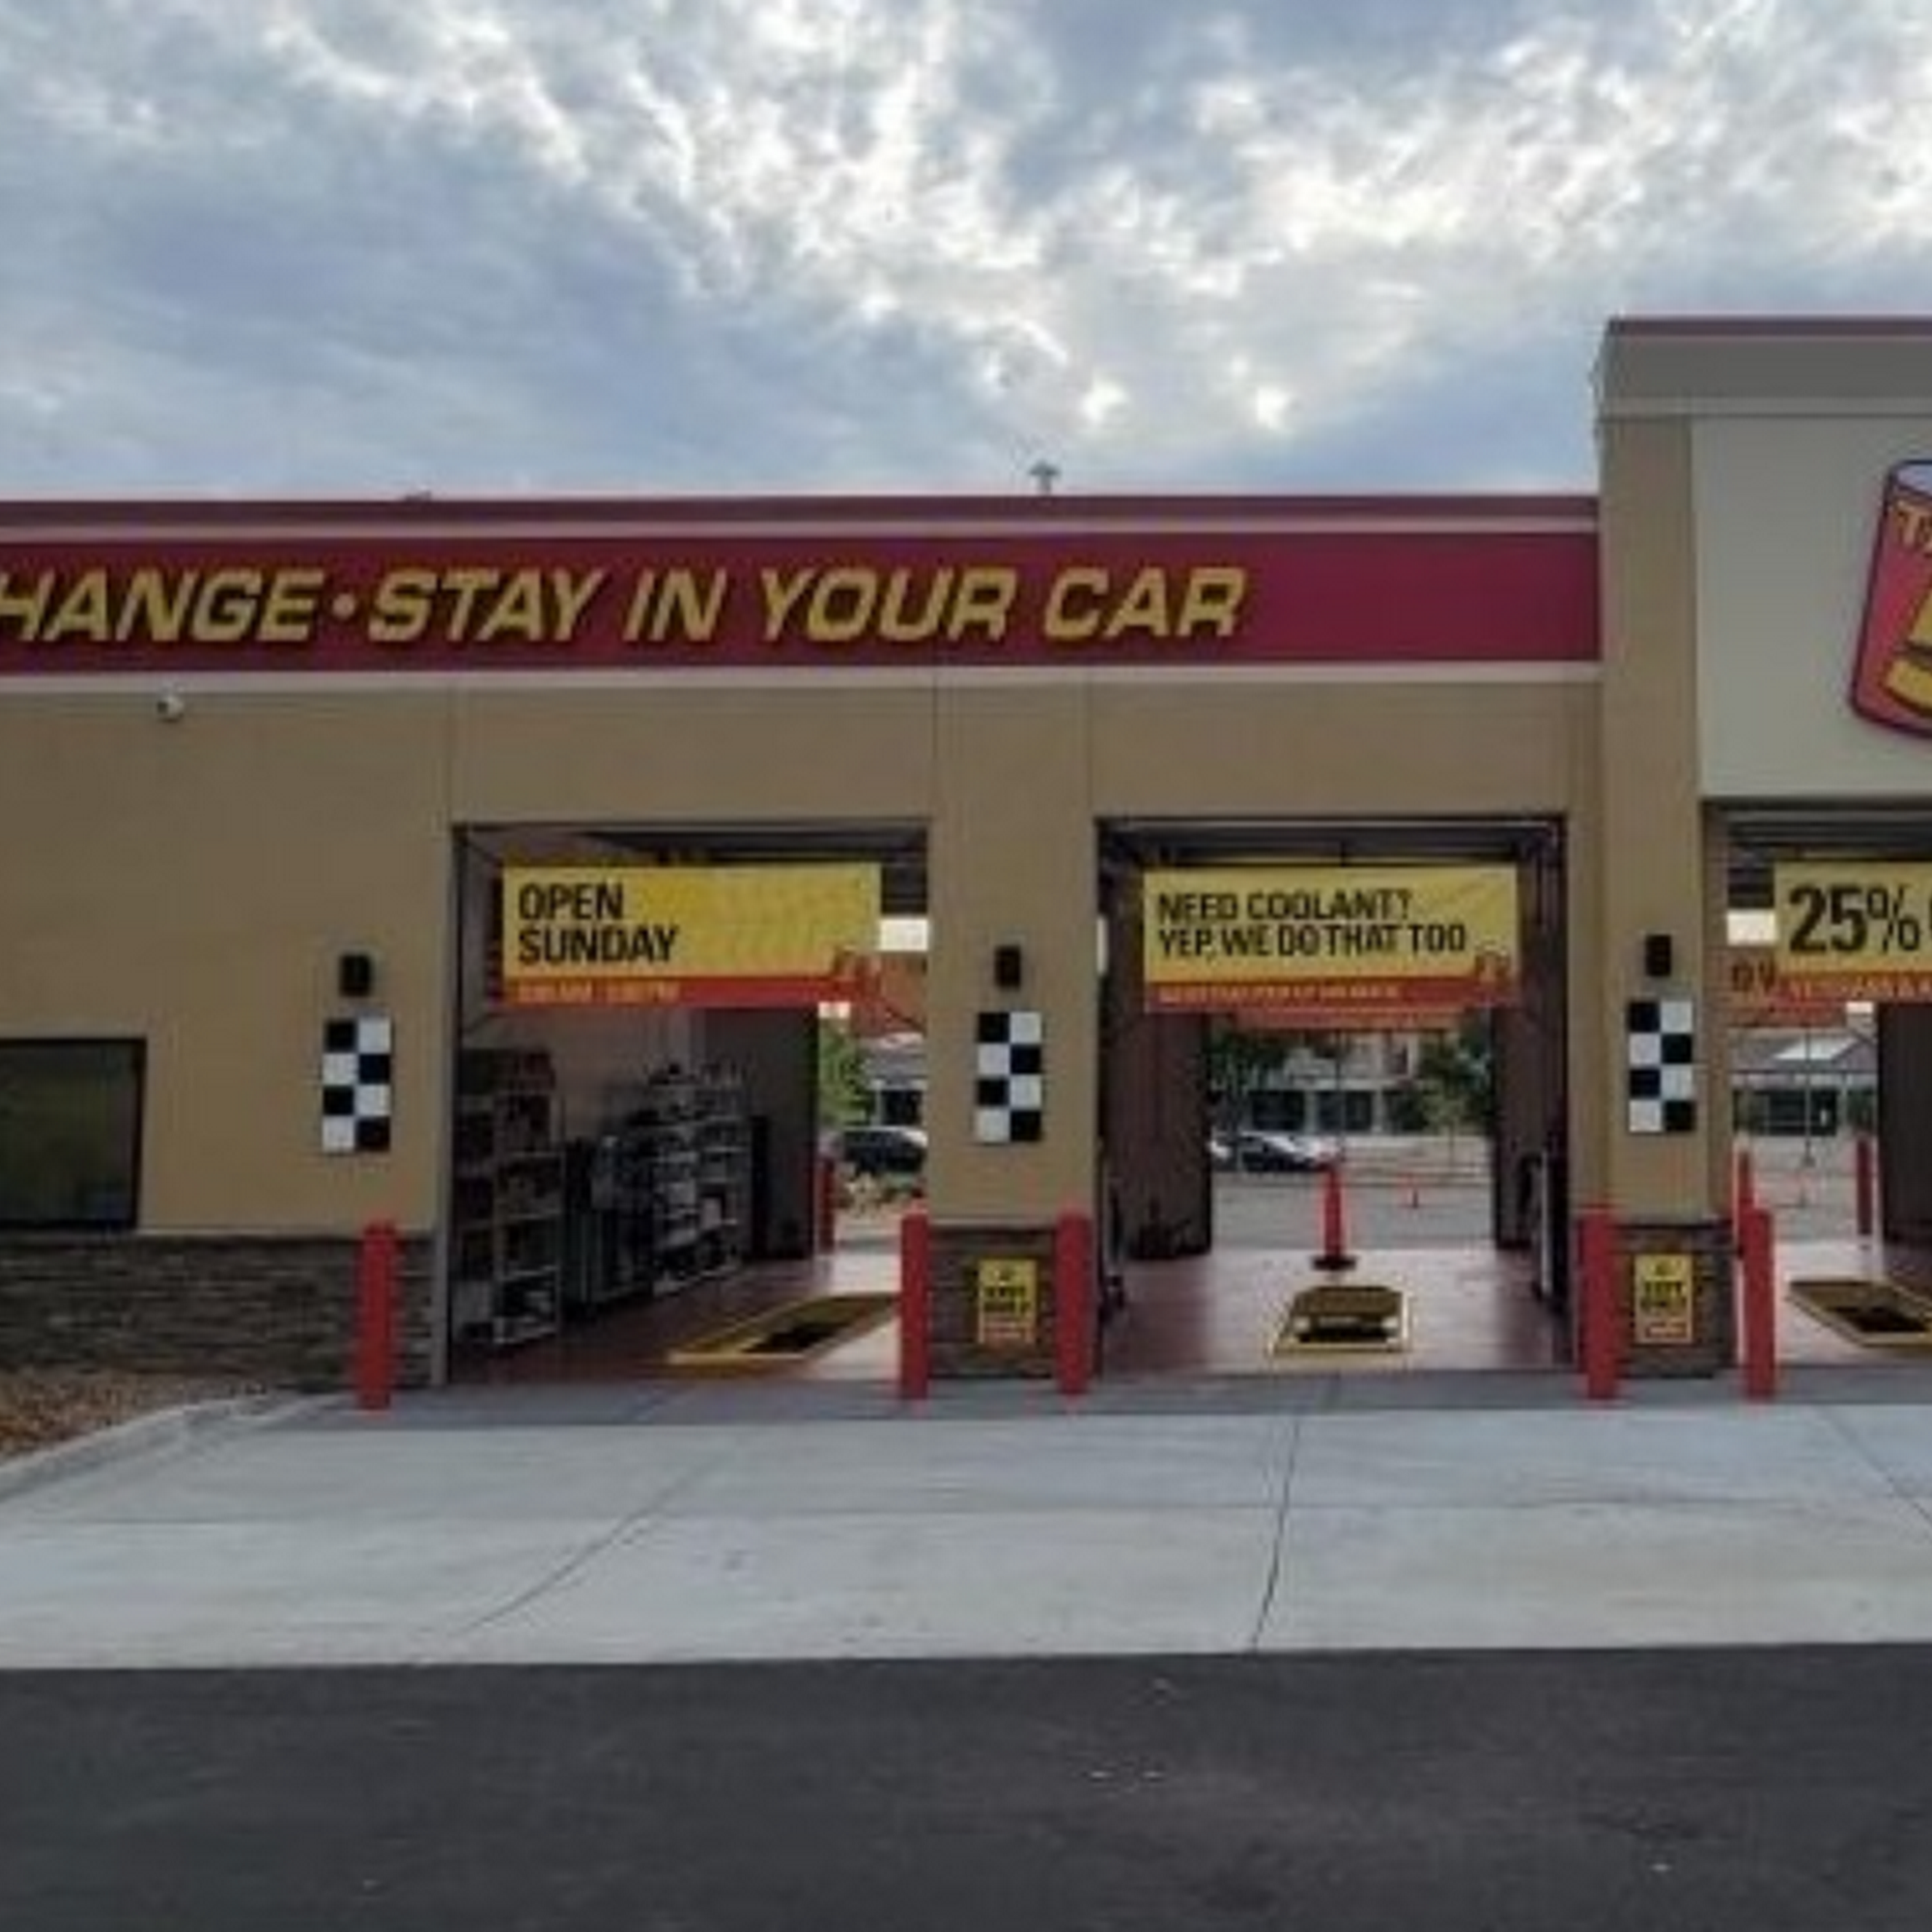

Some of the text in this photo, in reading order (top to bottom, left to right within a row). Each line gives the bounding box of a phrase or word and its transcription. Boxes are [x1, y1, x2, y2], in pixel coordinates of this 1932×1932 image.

[367, 567, 605, 641] STAY
[623, 568, 727, 640] IN
[760, 567, 1018, 640] YOUR
[1042, 567, 1246, 639] CAR
[518, 883, 623, 920] OPEN
[1158, 889, 1412, 922] NEED COOLANT?
[1789, 883, 1920, 955] 25%
[518, 925, 678, 963] SUNDAY
[1221, 924, 1269, 956] WE
[1278, 924, 1321, 956] DO
[1321, 923, 1401, 956] THAT
[1410, 923, 1467, 954] TOO
